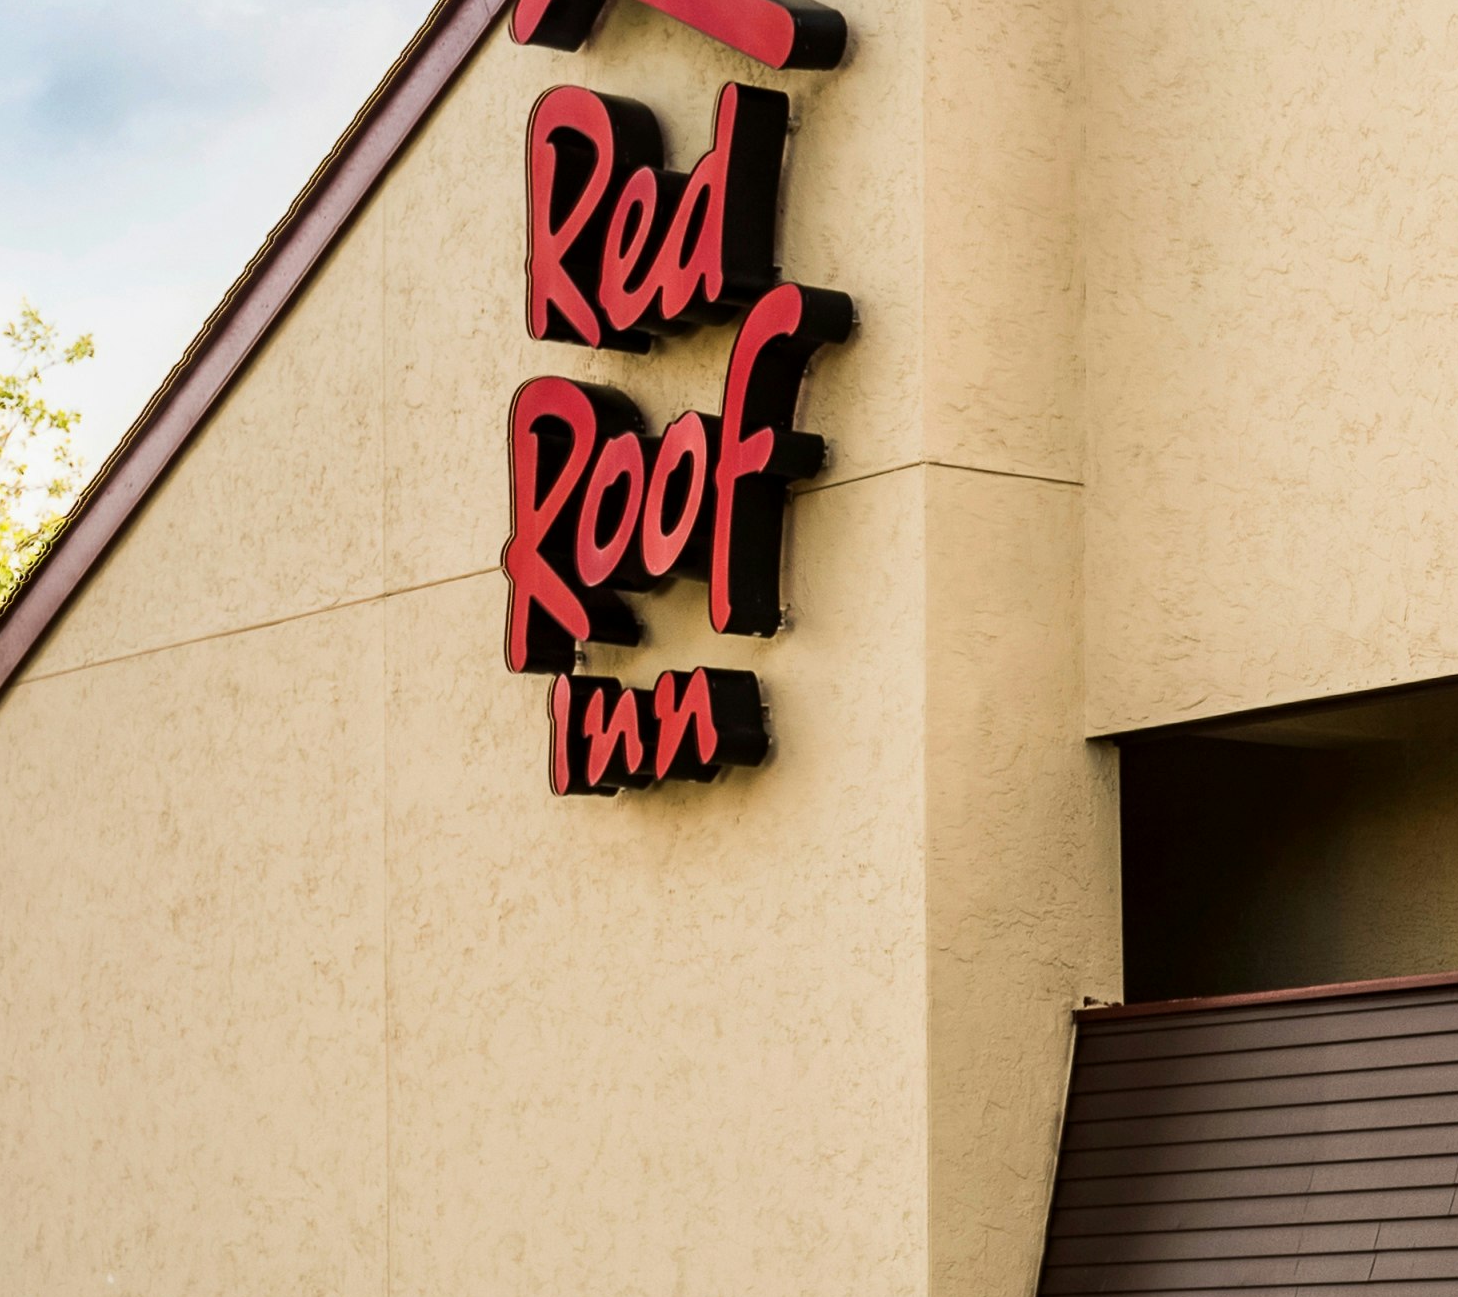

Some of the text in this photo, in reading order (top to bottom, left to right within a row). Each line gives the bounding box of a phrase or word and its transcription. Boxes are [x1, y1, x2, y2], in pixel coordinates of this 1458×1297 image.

[528, 82, 740, 350] Red
[504, 282, 803, 673] Roof
[550, 667, 719, 797] Inn
